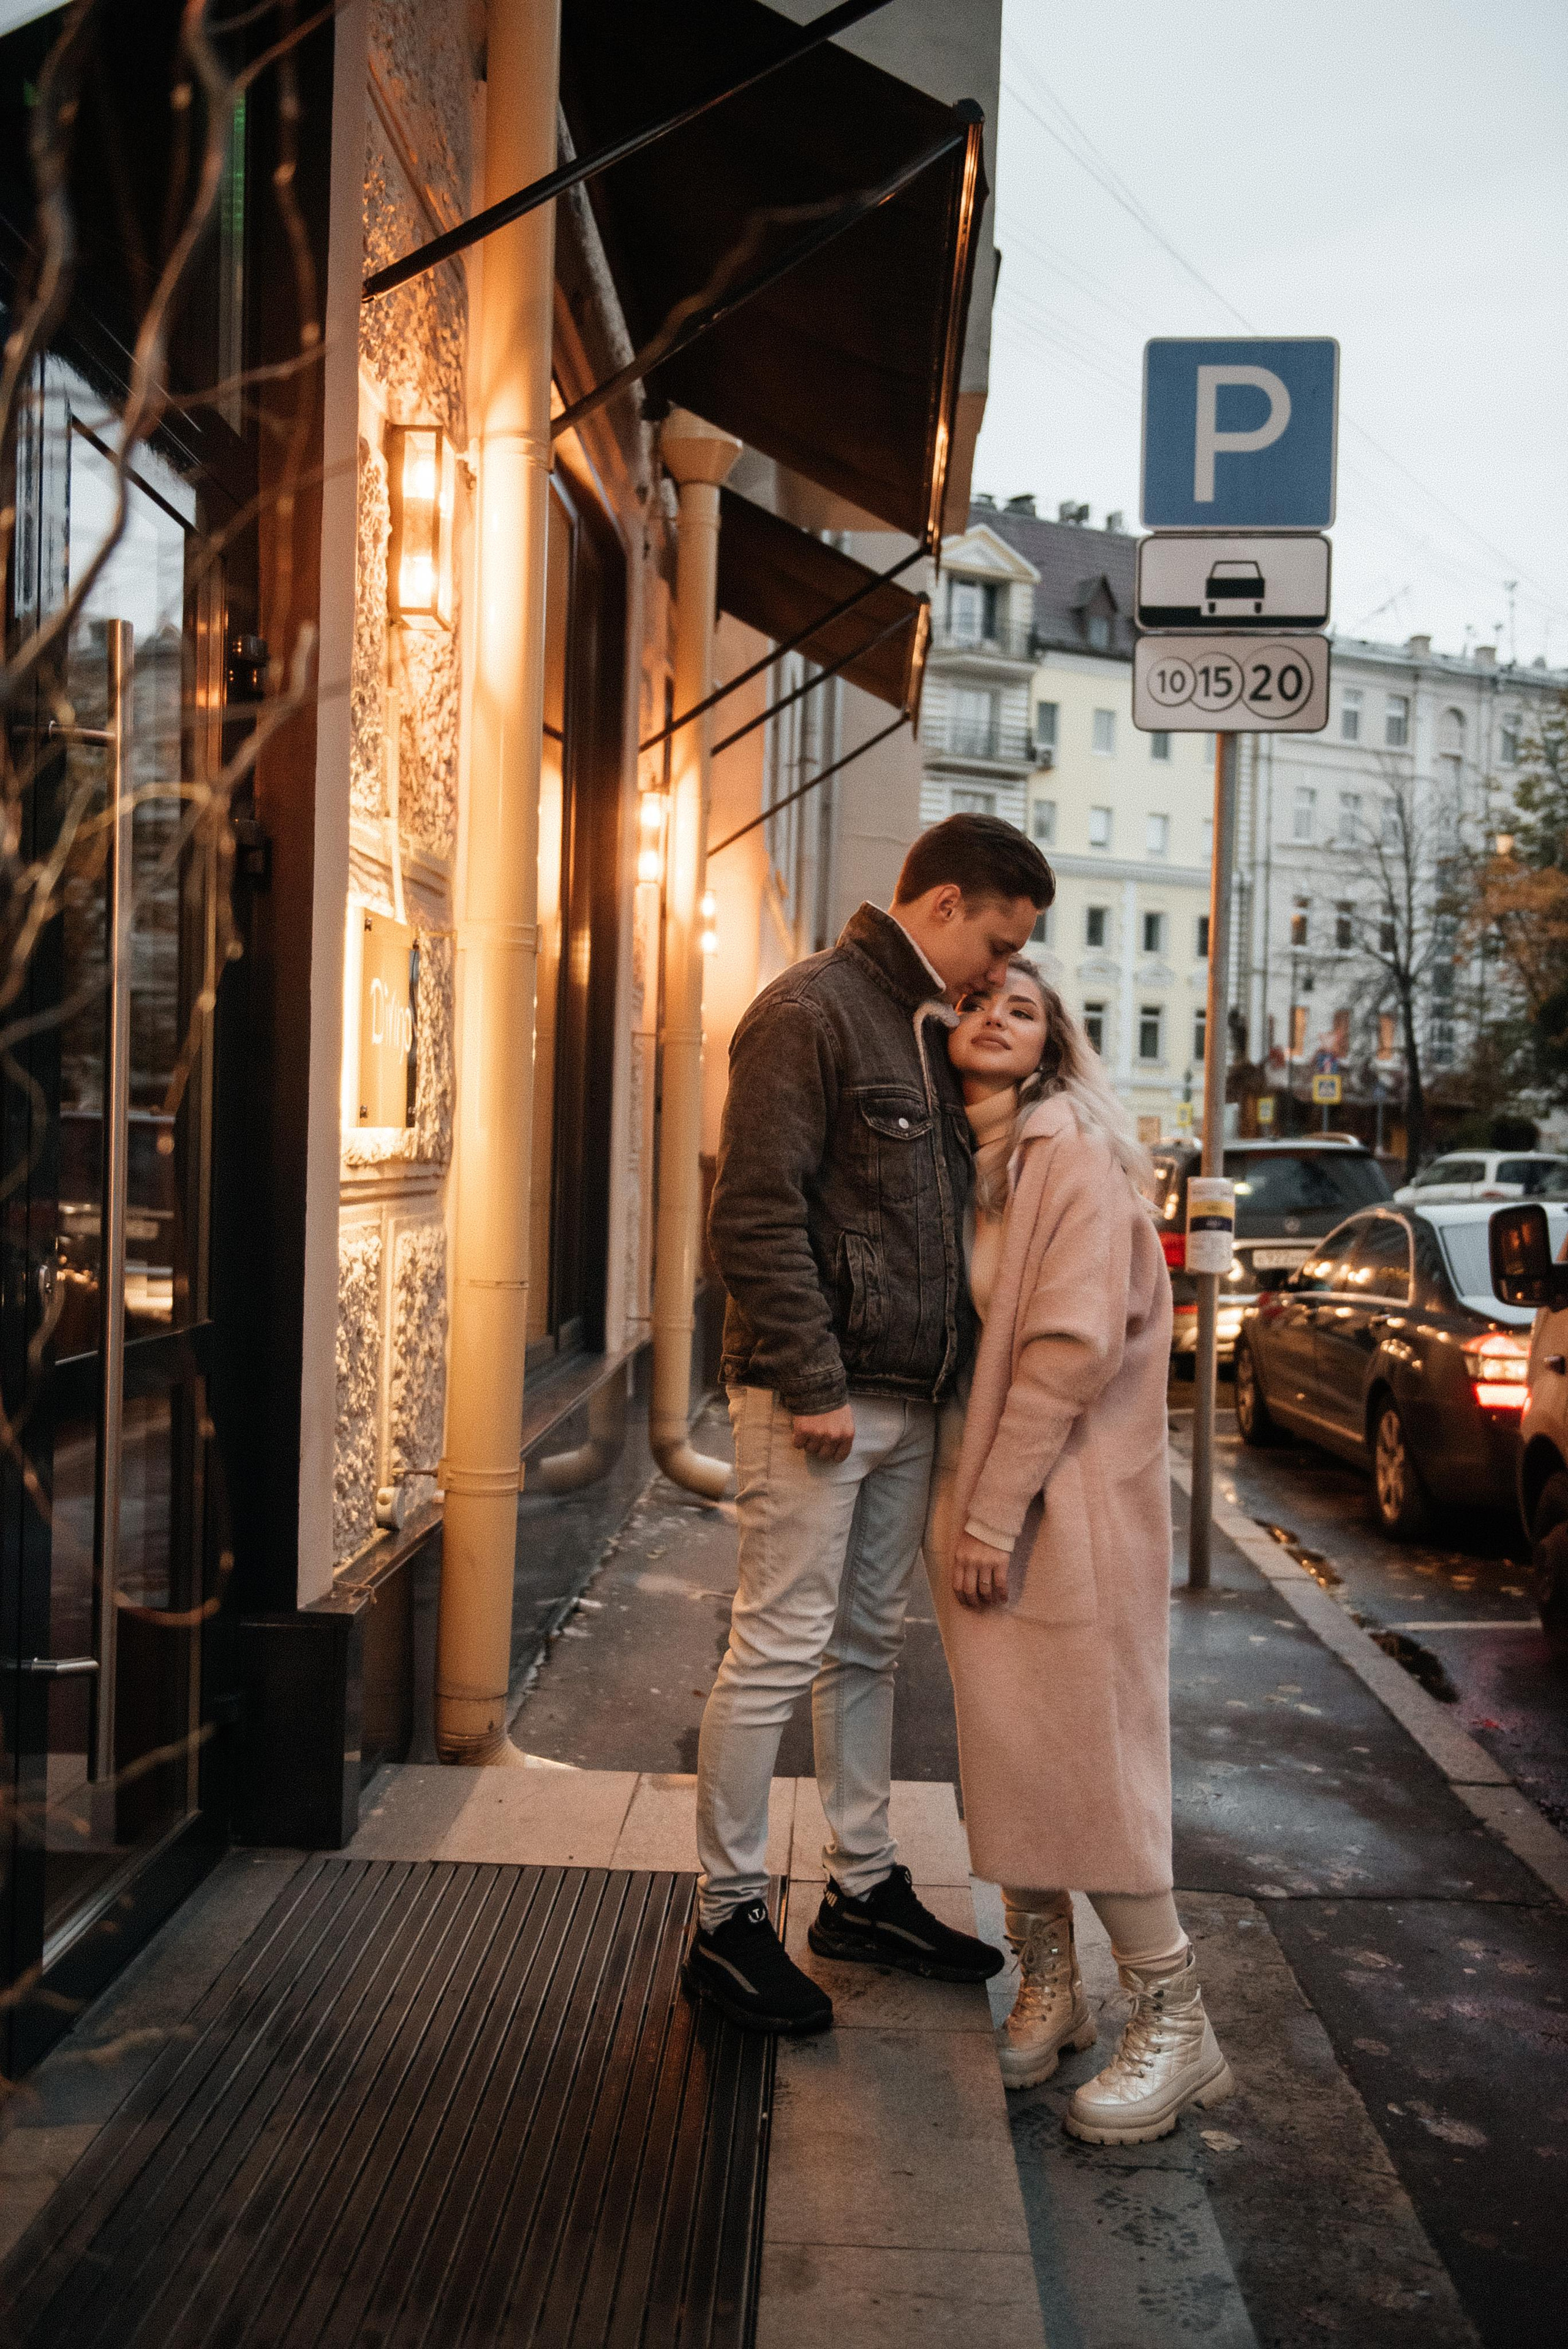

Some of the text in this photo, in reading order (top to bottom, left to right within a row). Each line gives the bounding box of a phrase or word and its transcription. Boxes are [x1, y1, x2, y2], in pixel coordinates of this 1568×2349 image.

[1193, 365, 1292, 502] P
[1158, 664, 1303, 702] 10 15 20
